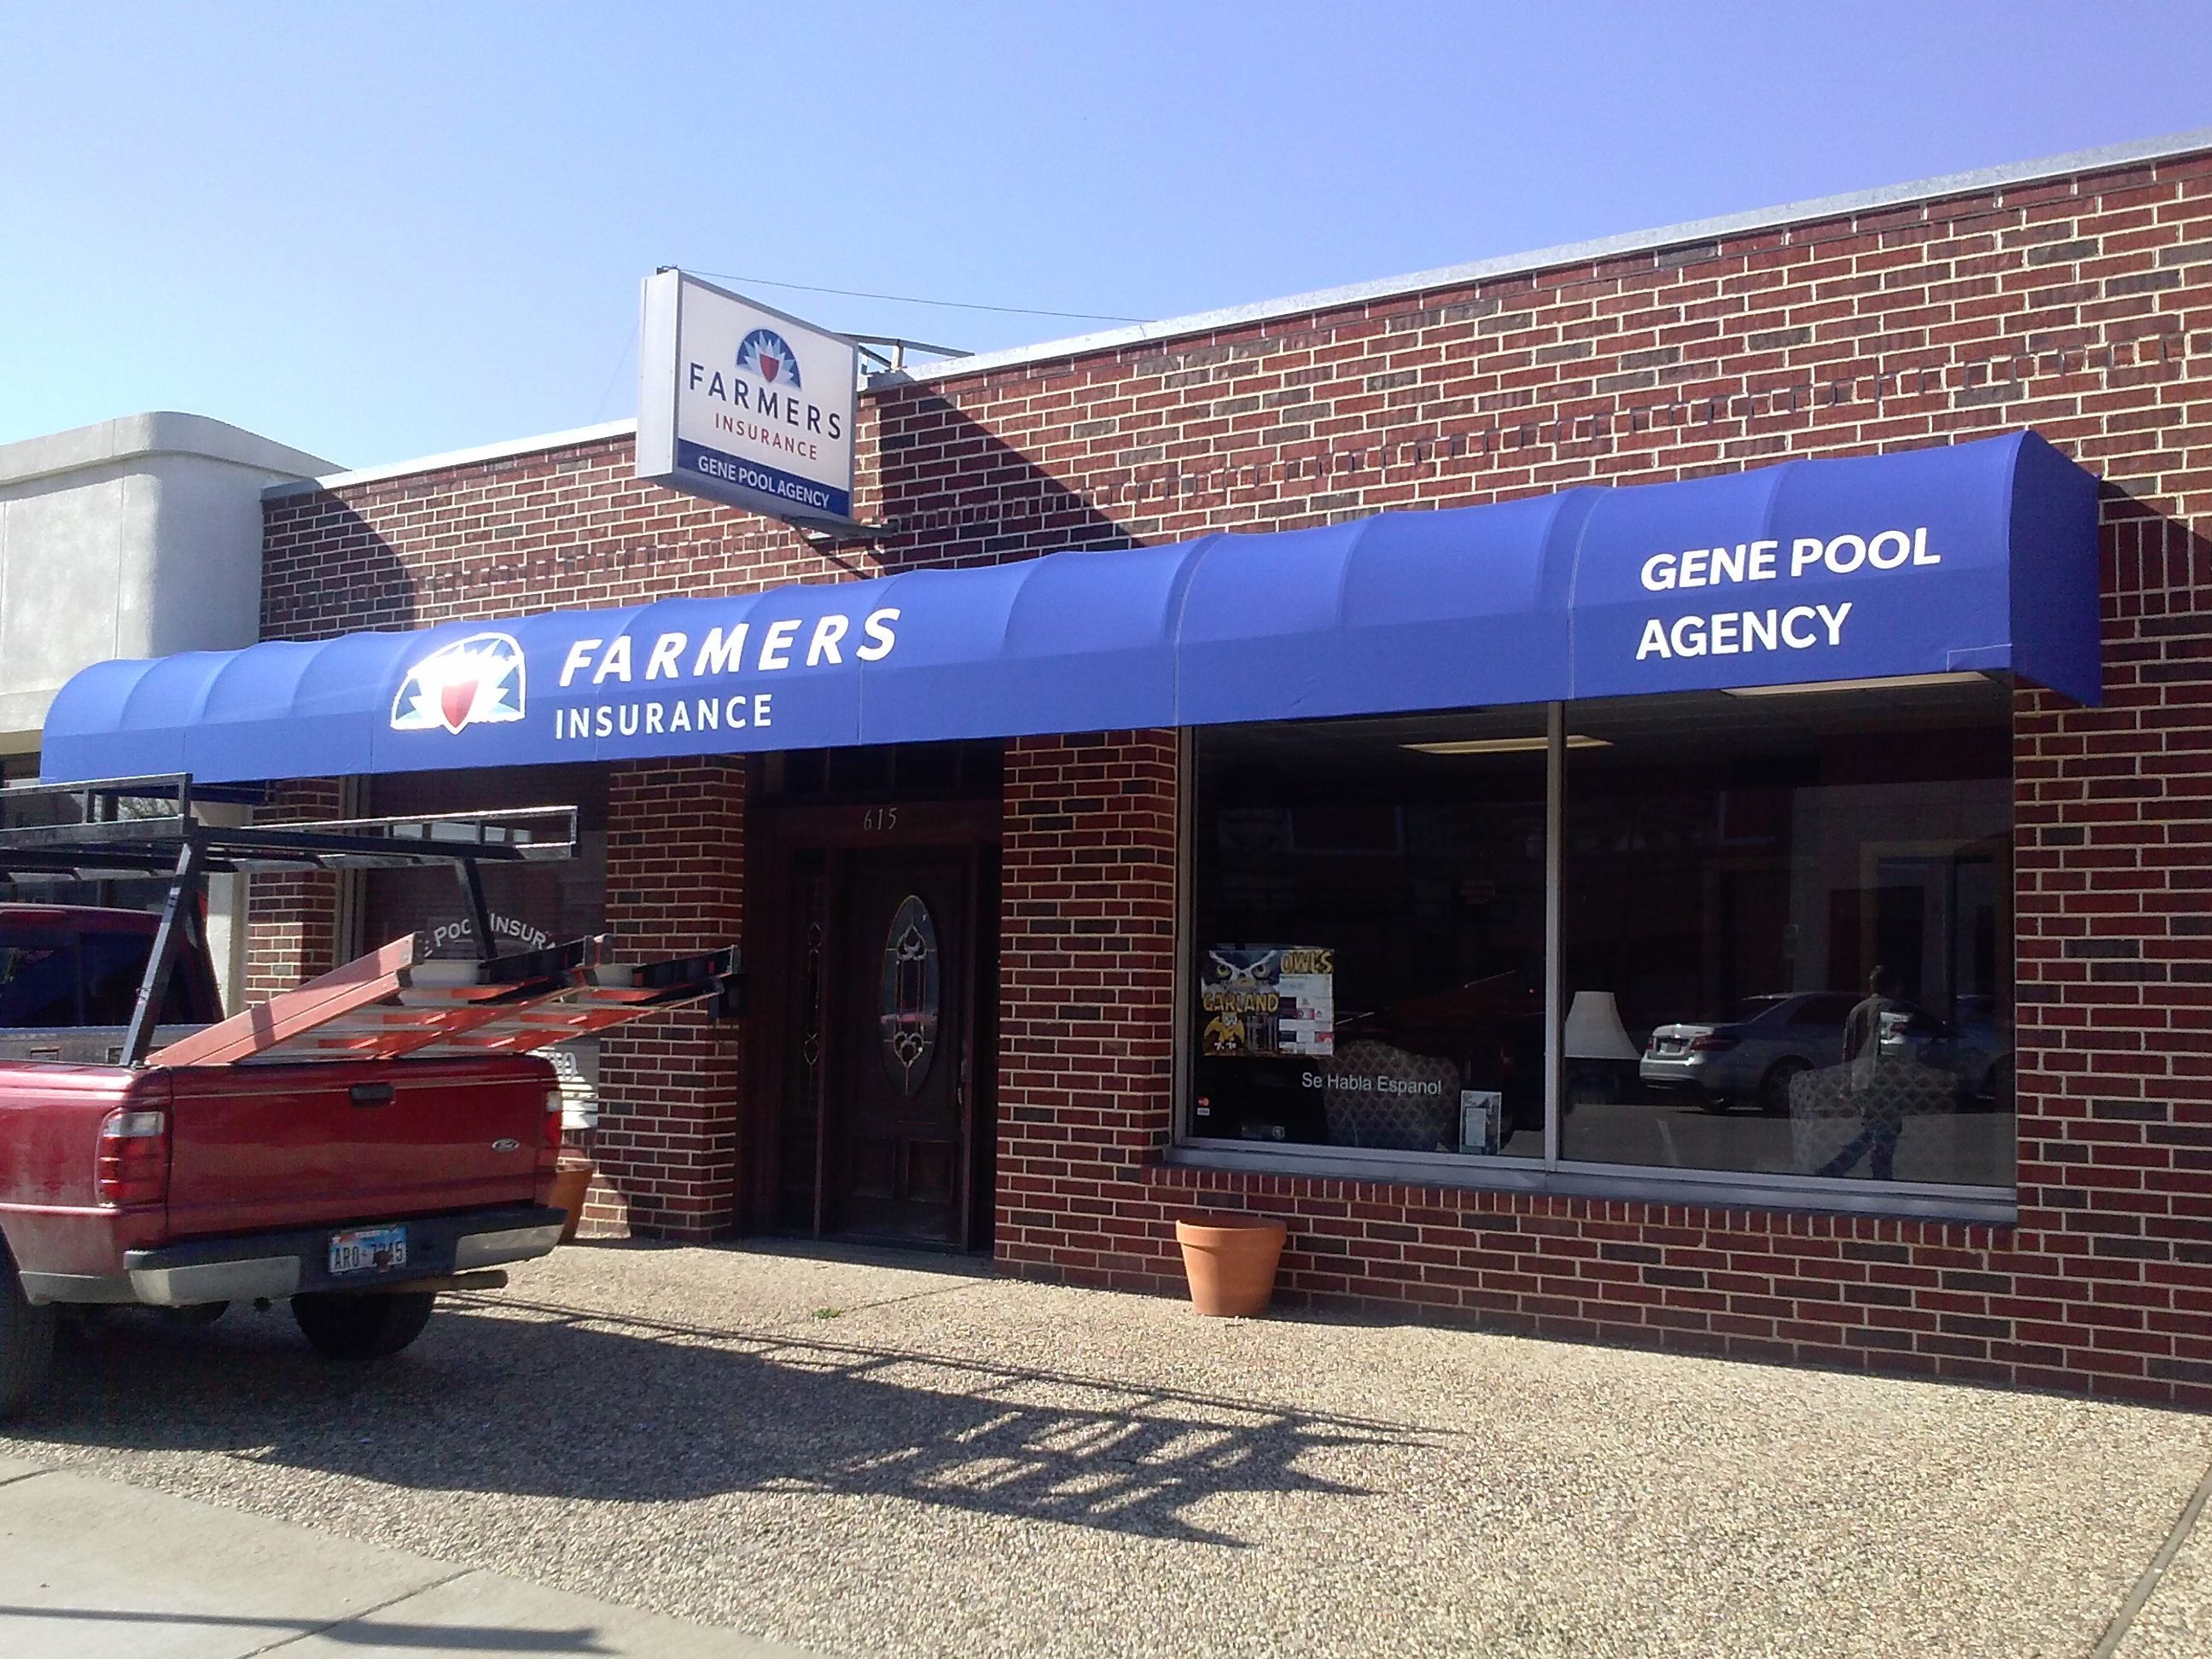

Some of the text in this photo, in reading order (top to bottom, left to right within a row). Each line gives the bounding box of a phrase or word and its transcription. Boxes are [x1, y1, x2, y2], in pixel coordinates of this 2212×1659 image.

[689, 363, 841, 439] FARMERS
[714, 412, 818, 461] INSURANCE
[697, 455, 830, 509] GENE POOL AGENCY
[1640, 527, 1941, 591] GENE POOL
[559, 608, 901, 688] FARMERS
[1635, 602, 1853, 661] AGENCY
[556, 694, 773, 740] INSURANCE
[864, 807, 898, 830] 615
[1280, 951, 1334, 974] OWLS
[1203, 992, 1280, 1013] GARLAND
[1302, 1072, 1442, 1096] Se Habla Espanol
